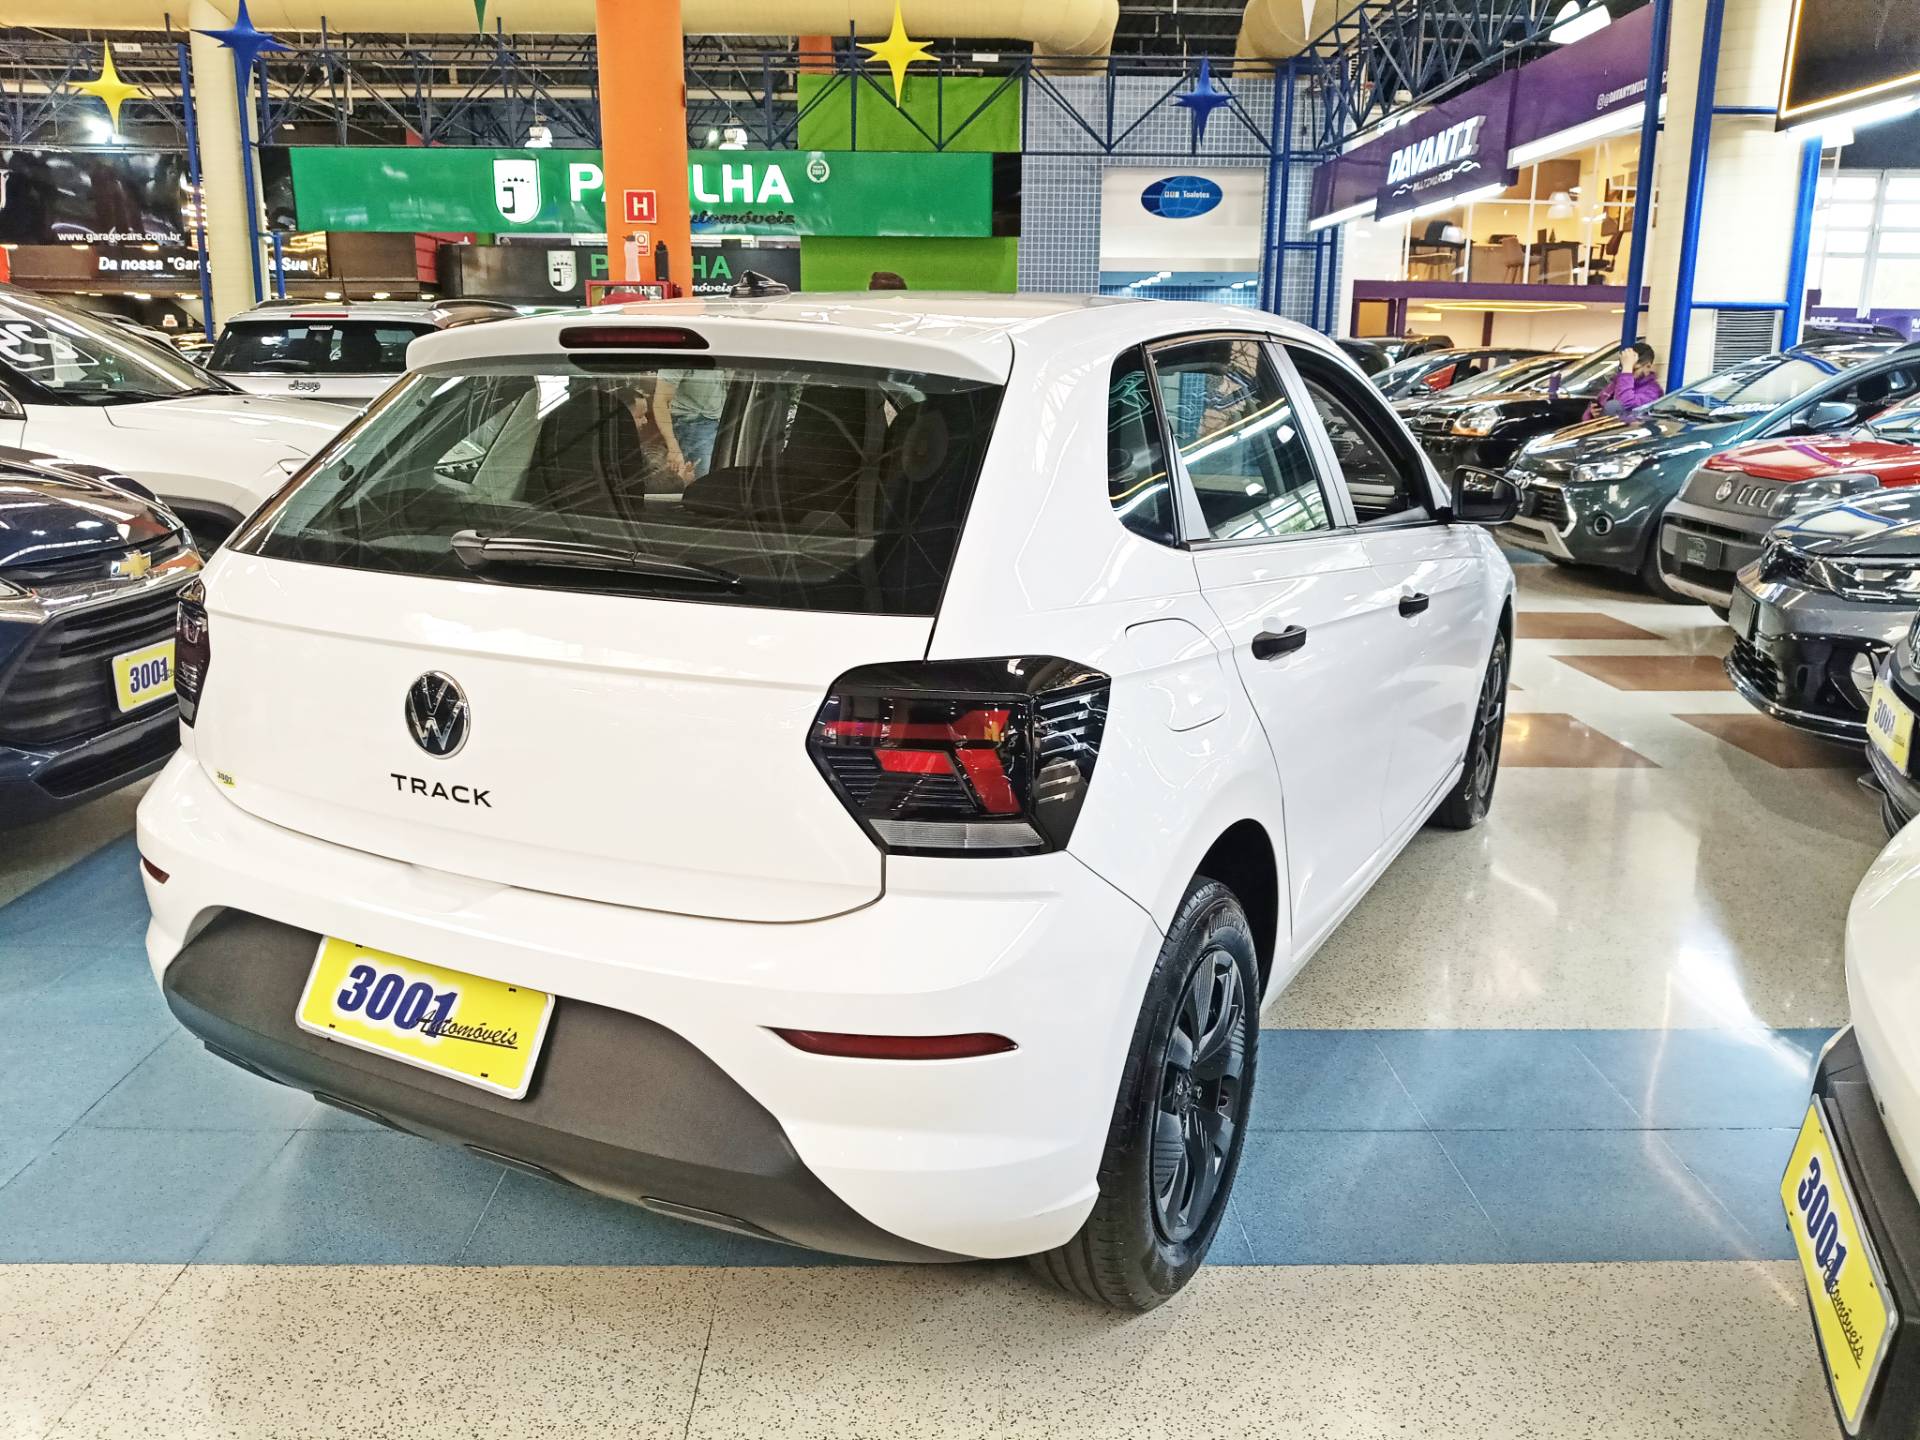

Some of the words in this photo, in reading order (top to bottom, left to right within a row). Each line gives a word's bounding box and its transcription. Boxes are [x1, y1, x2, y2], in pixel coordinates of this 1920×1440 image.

[1386, 115, 1485, 185] DAVANTI
[633, 197, 648, 216] H
[690, 209, 796, 225] utomóveis
[57, 231, 182, 243] www.garagecars.com.br
[99, 256, 118, 271] Da
[121, 259, 163, 271] nossa
[281, 257, 308, 271] Sua
[288, 379, 321, 392] Jeep
[130, 656, 169, 694] 3001
[1874, 698, 1896, 735] 3001
[390, 772, 492, 808] TRACK
[337, 964, 458, 1038] 3001
[416, 1008, 518, 1050] Automóveis
[1798, 1157, 1847, 1294] 3001
